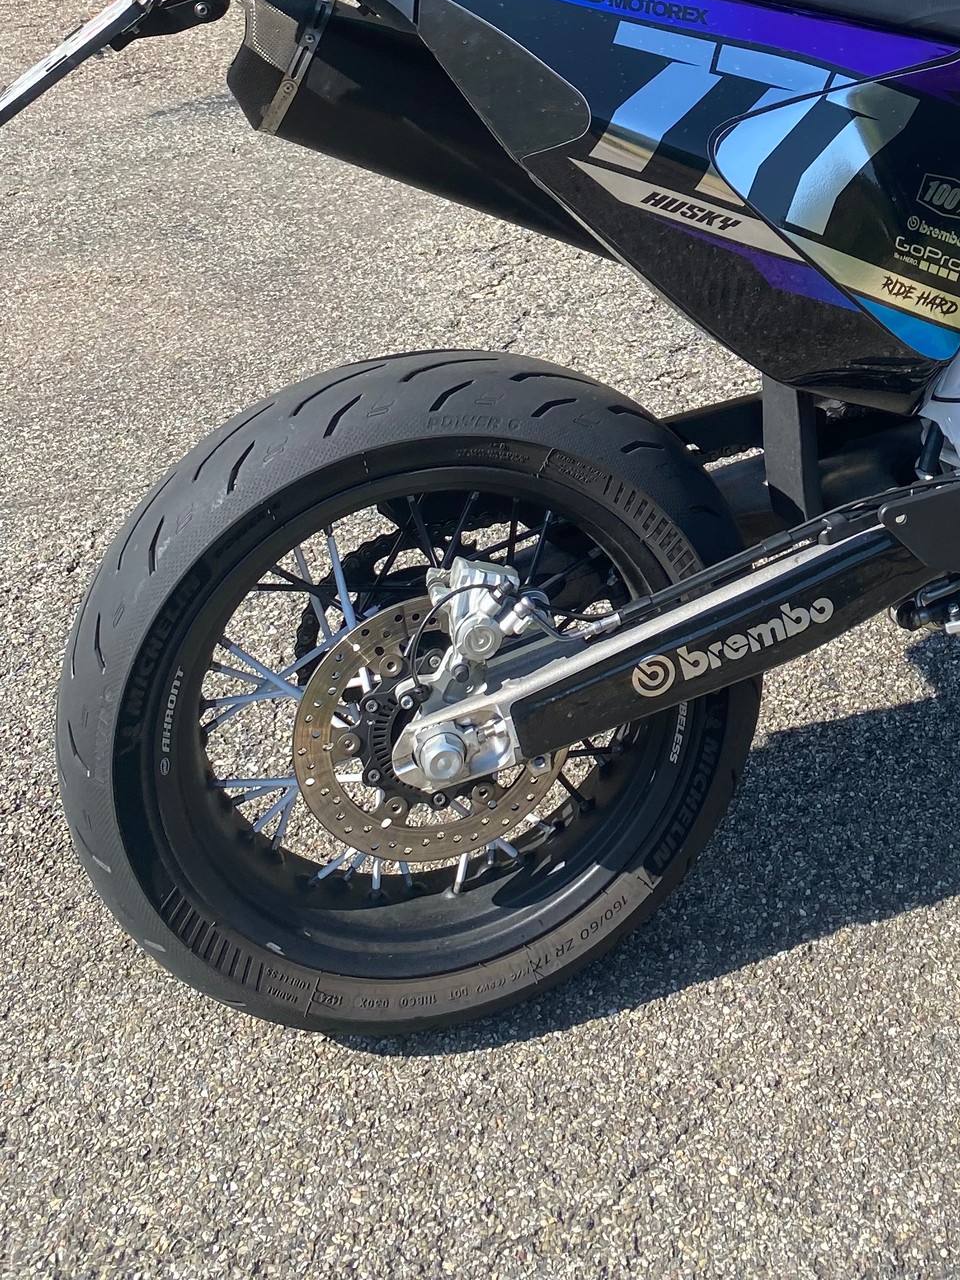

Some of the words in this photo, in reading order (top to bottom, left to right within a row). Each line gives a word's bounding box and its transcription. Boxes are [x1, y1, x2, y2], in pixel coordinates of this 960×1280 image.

[640, 192, 742, 232] HUSKY
[881, 274, 917, 300] RIDE
[915, 290, 958, 318] HARD
[677, 597, 834, 681] brembo
[669, 701, 688, 764] BELESS
[653, 734, 719, 869] MICHELIN
[580, 895, 628, 941] 160/60
[555, 937, 576, 958] ZR
